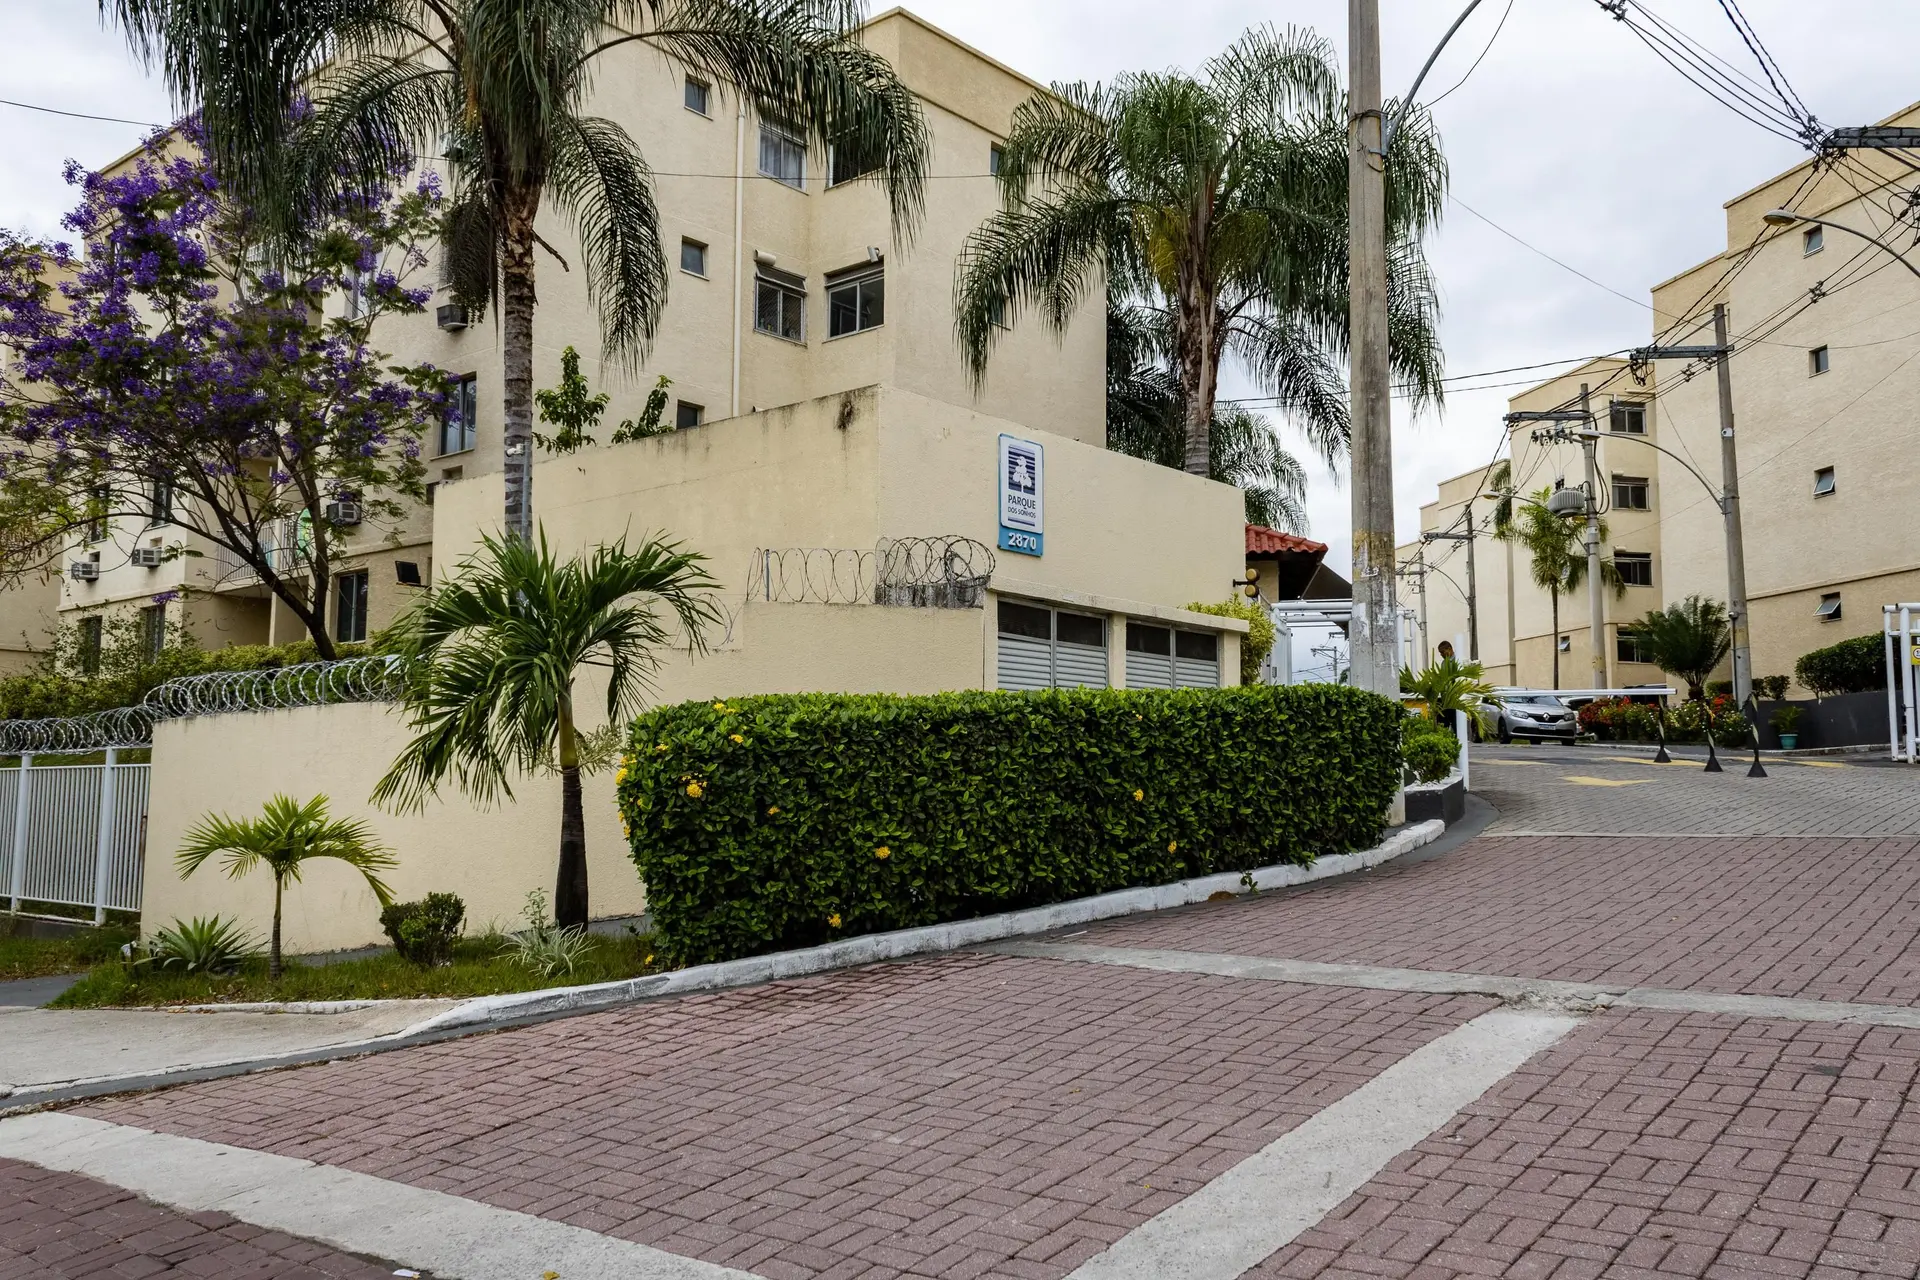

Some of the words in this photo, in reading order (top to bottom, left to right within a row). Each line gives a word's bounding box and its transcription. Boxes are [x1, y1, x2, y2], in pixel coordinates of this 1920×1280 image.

[1008, 495, 1036, 509] PARQUE
[1008, 506, 1017, 514] DOS
[1018, 509, 1036, 518] SONHOS
[1008, 532, 1036, 550] 2870
